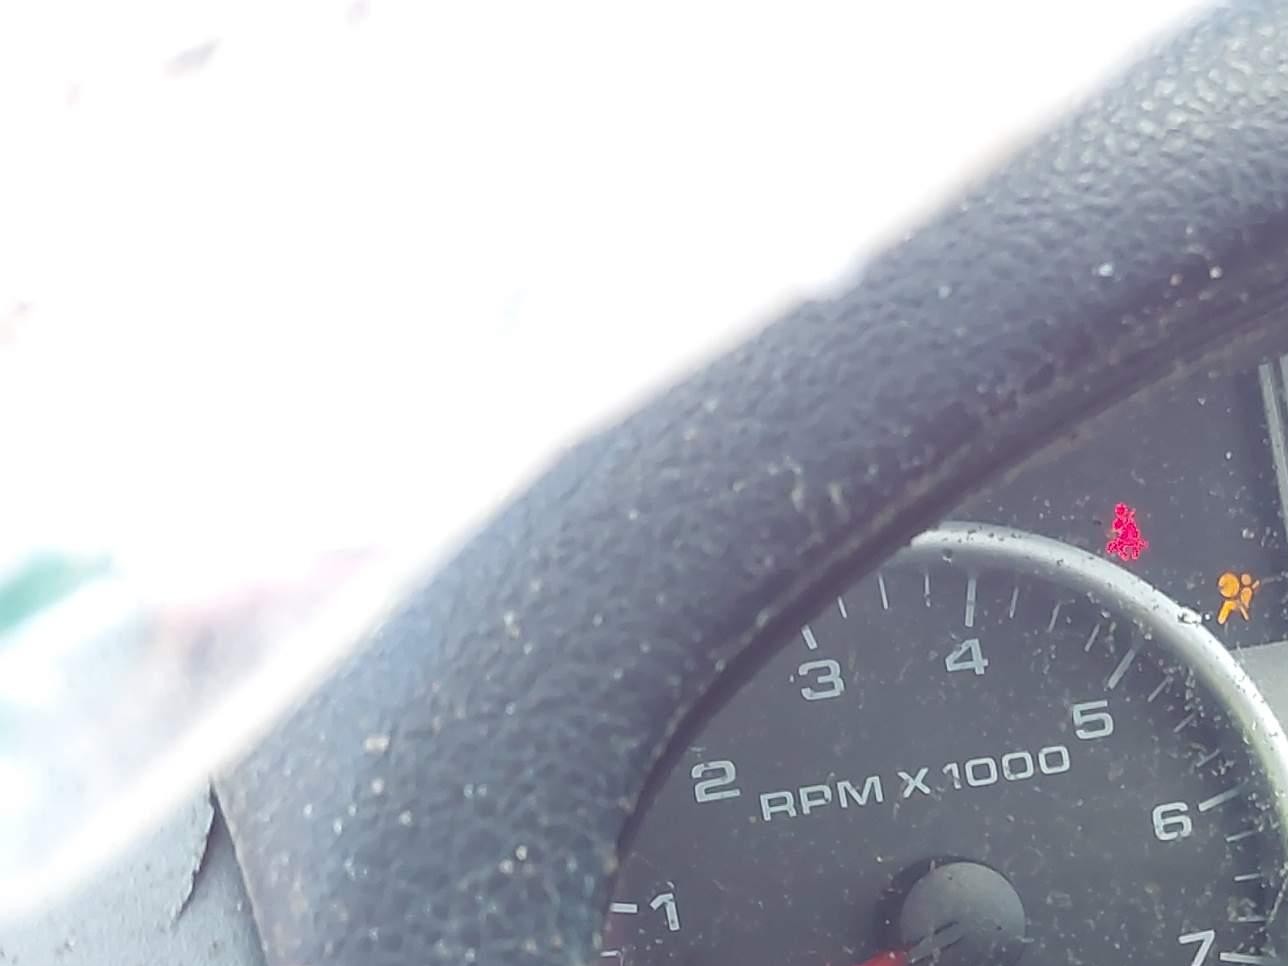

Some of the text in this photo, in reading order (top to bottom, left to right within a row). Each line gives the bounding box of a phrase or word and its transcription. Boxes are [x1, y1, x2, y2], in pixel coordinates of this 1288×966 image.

[945, 638, 989, 675] 4
[798, 659, 844, 700] 3
[1073, 701, 1115, 740] 5
[691, 760, 741, 802] 2
[759, 745, 1071, 821] RPM X 1000
[1152, 802, 1192, 841] 6
[649, 892, 680, 931] 1
